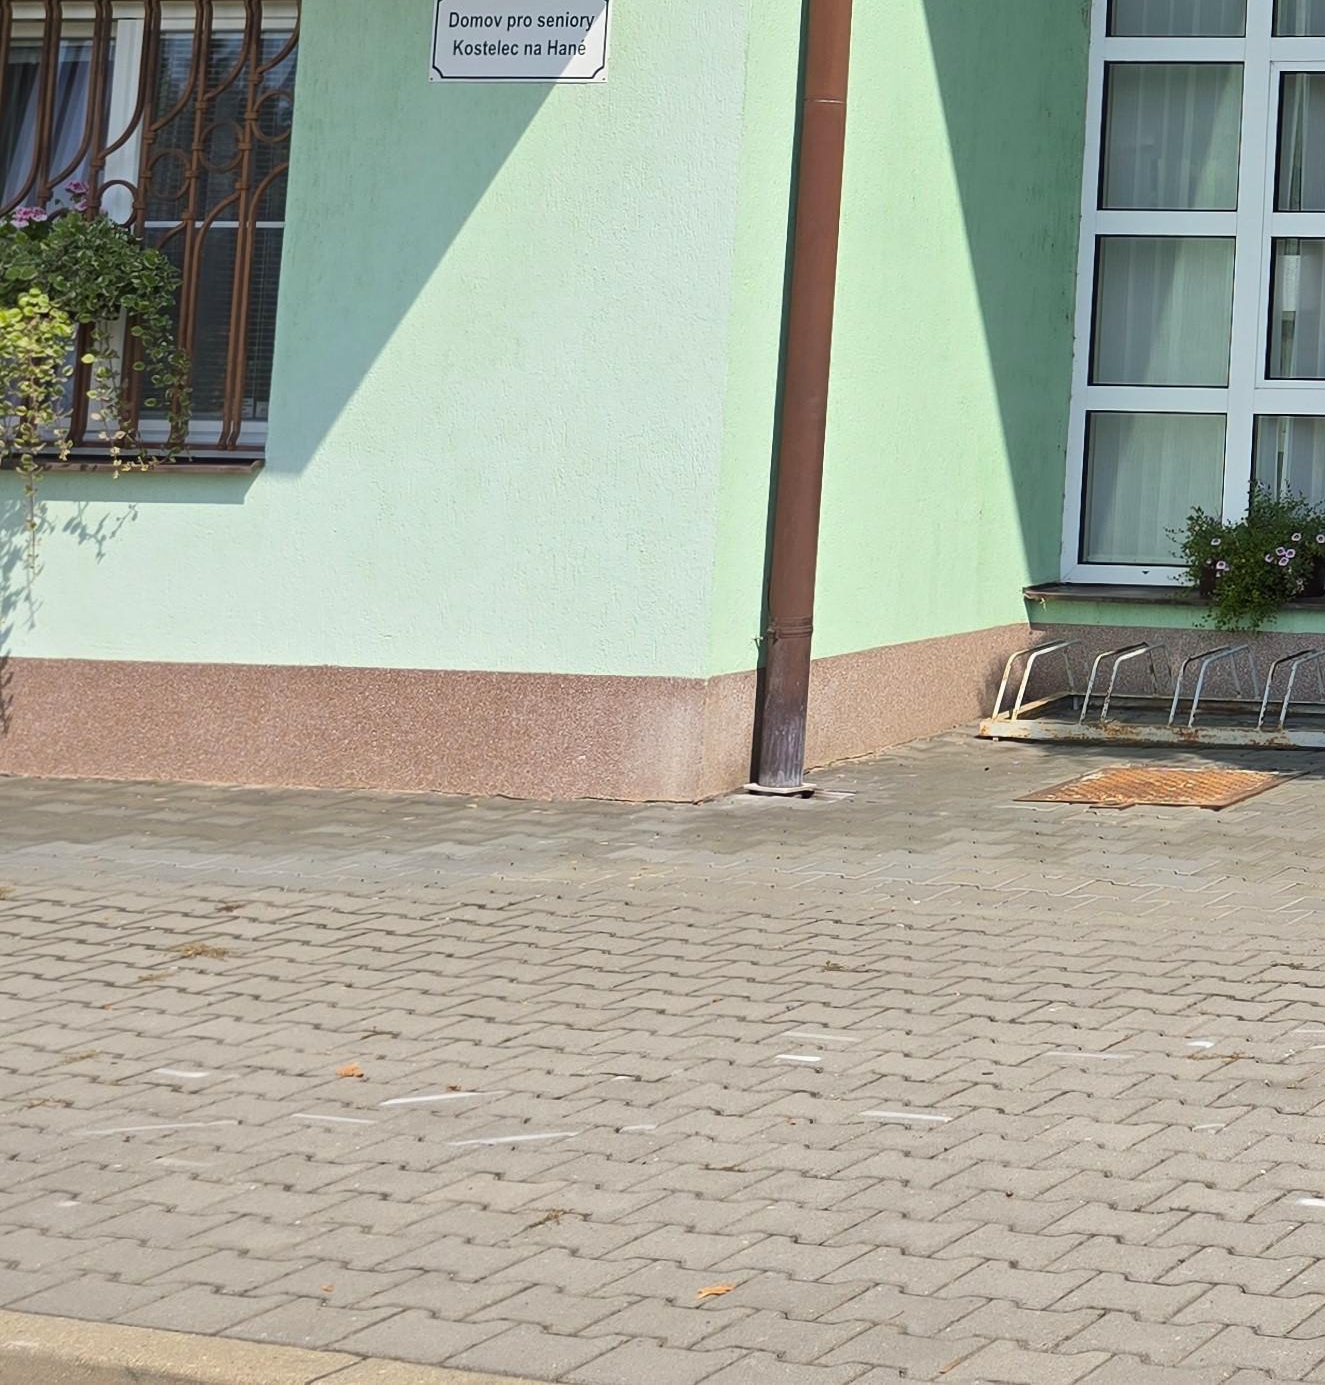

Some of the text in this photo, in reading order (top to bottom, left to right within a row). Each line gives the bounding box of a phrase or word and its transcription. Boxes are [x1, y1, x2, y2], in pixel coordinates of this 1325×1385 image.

[449, 11, 595, 31] Domov pro seniory
[453, 39, 587, 56] Kostelec na Hané
